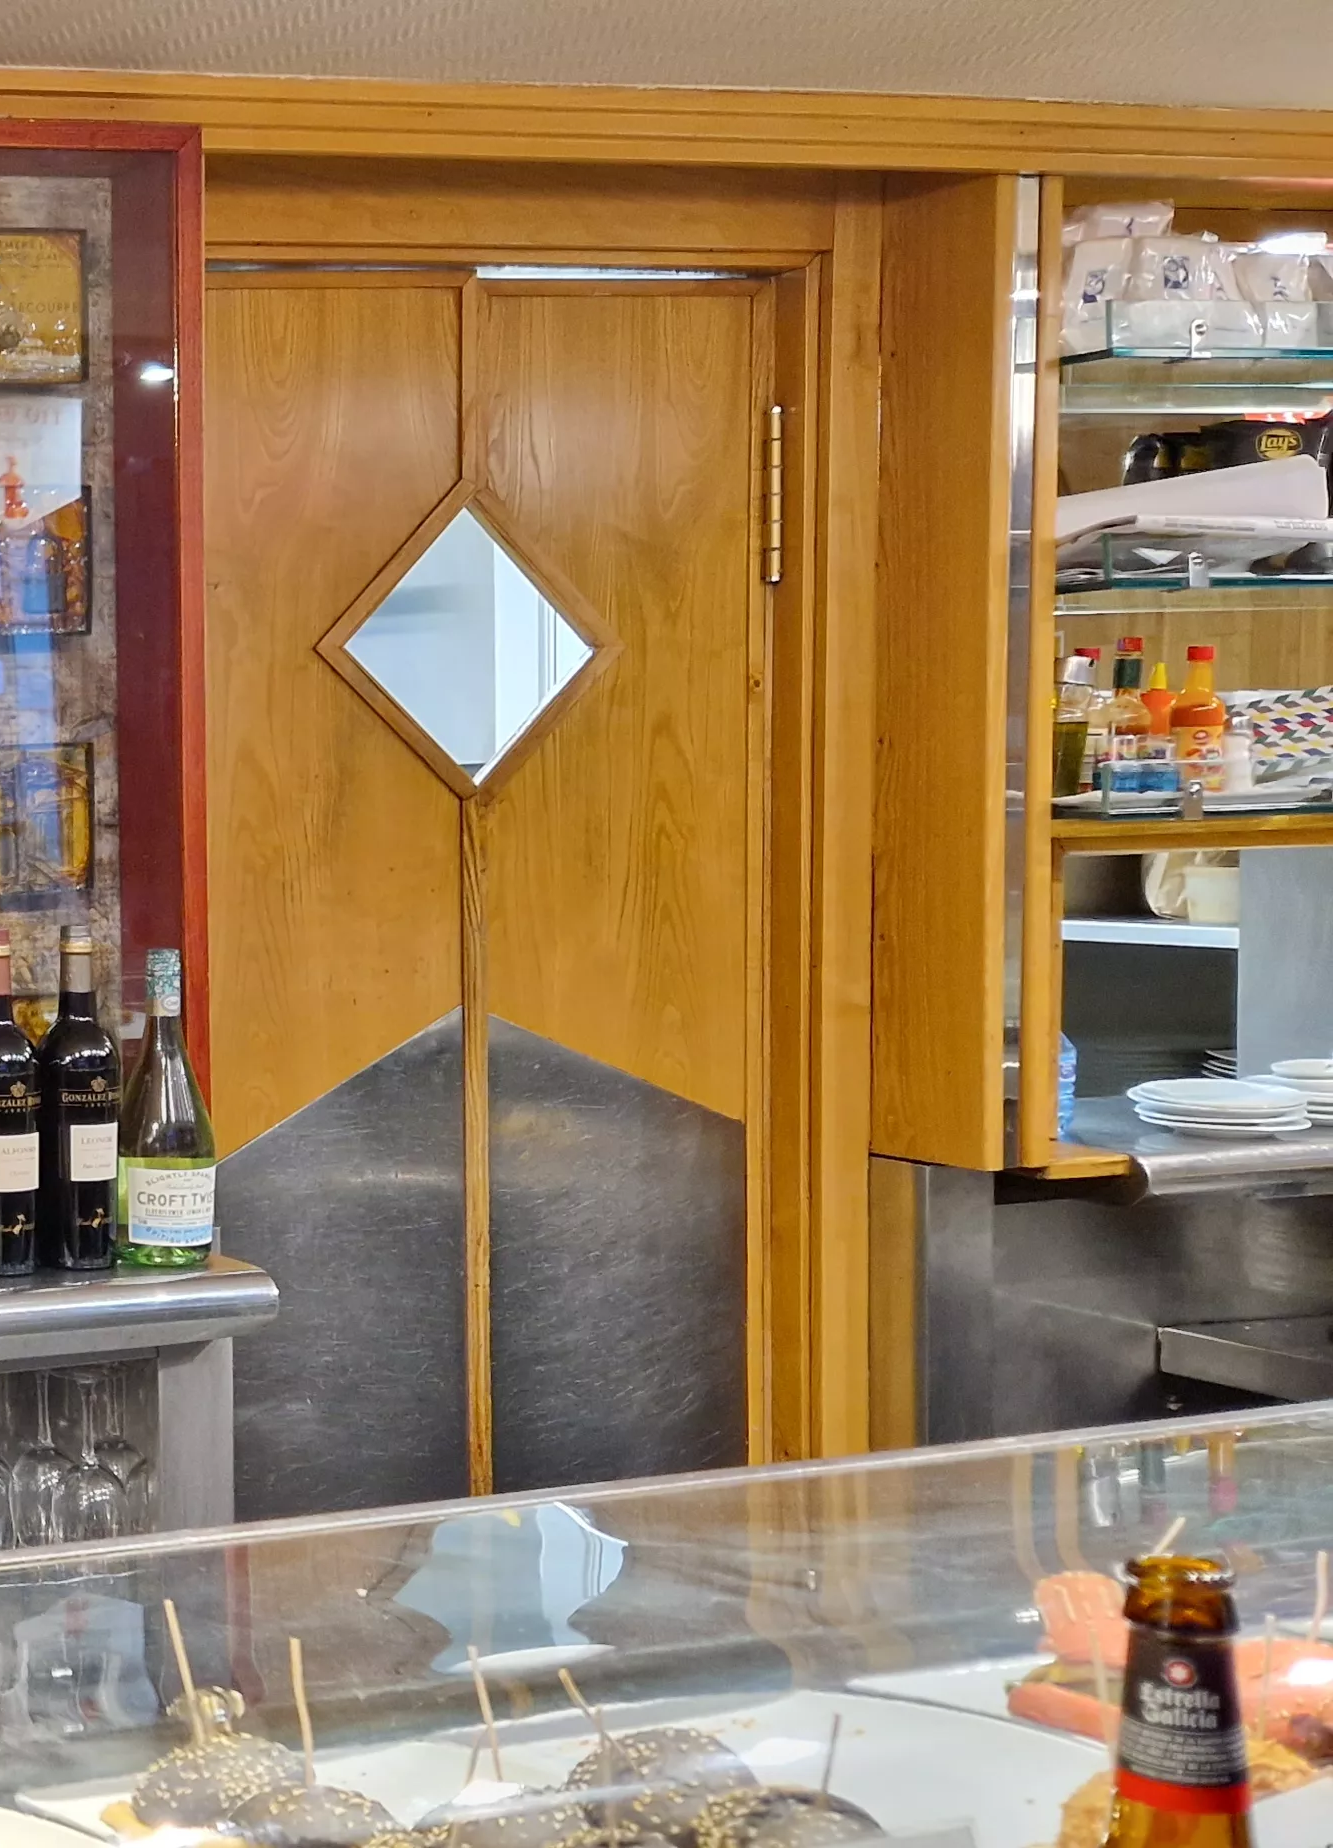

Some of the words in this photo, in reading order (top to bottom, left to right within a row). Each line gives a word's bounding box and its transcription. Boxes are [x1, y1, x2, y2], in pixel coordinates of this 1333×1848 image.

[137, 1191, 188, 1207] CROFT
[191, 1189, 214, 1206] TWIS
[1139, 1682, 1220, 1710] Estrella
[1140, 1702, 1218, 1729] Galicia
